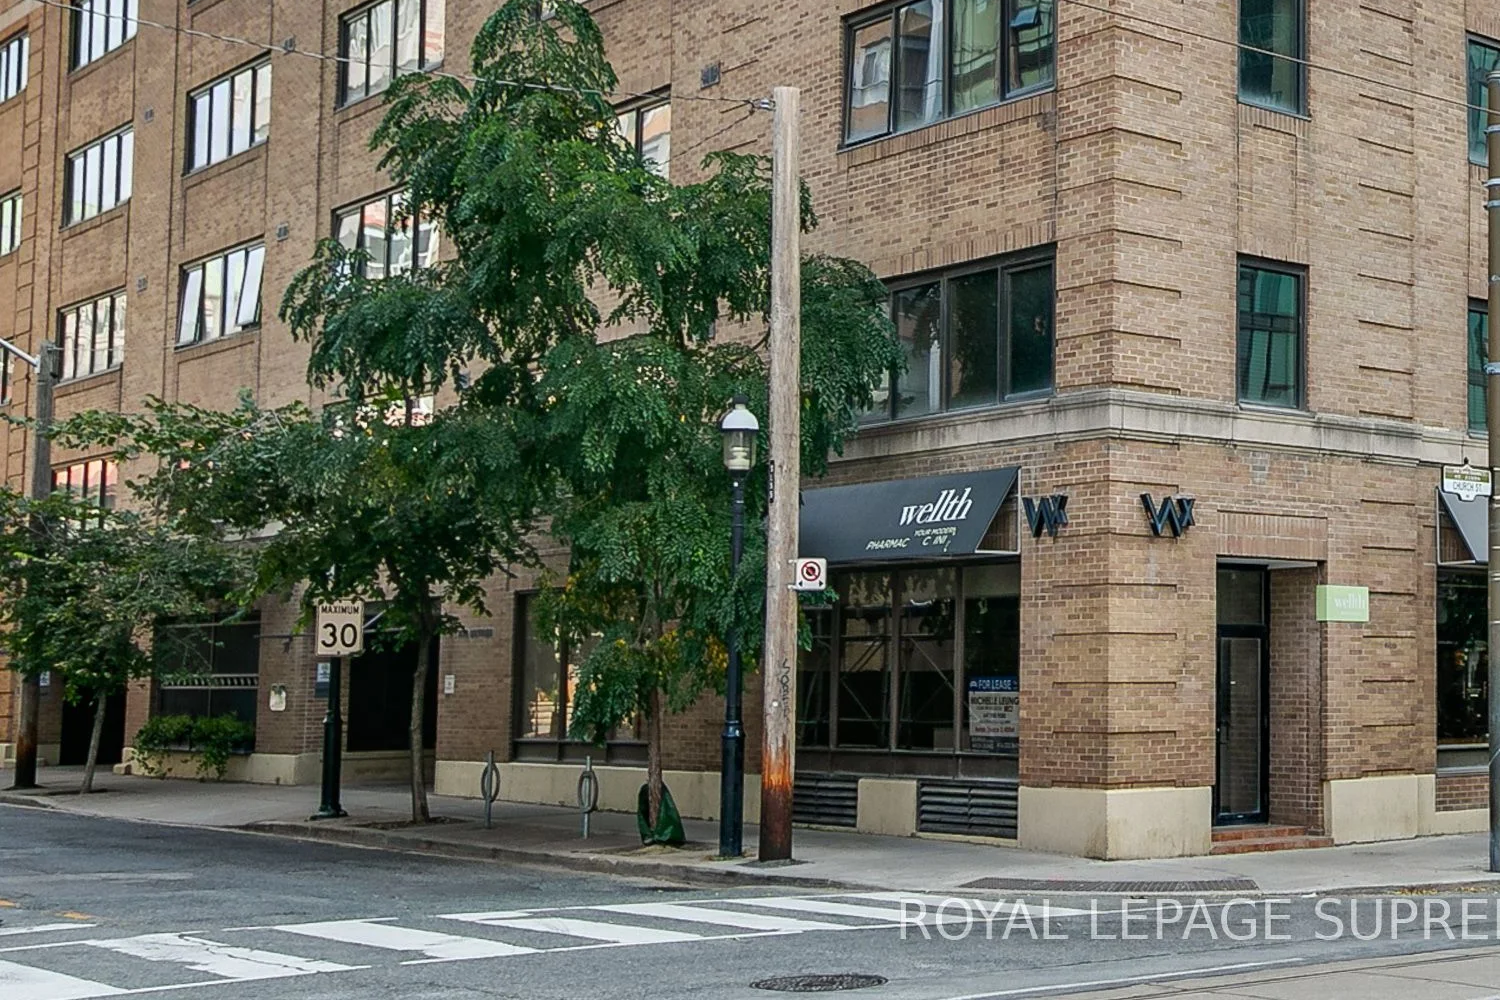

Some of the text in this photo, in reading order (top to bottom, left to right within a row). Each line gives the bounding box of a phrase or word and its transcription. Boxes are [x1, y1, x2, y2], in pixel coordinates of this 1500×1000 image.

[1453, 481, 1473, 491] CHURCH
[899, 487, 973, 526] wellth
[321, 605, 359, 614] MAXIMUM
[321, 623, 357, 648] 30
[978, 679, 1012, 690] FOR LEASE
